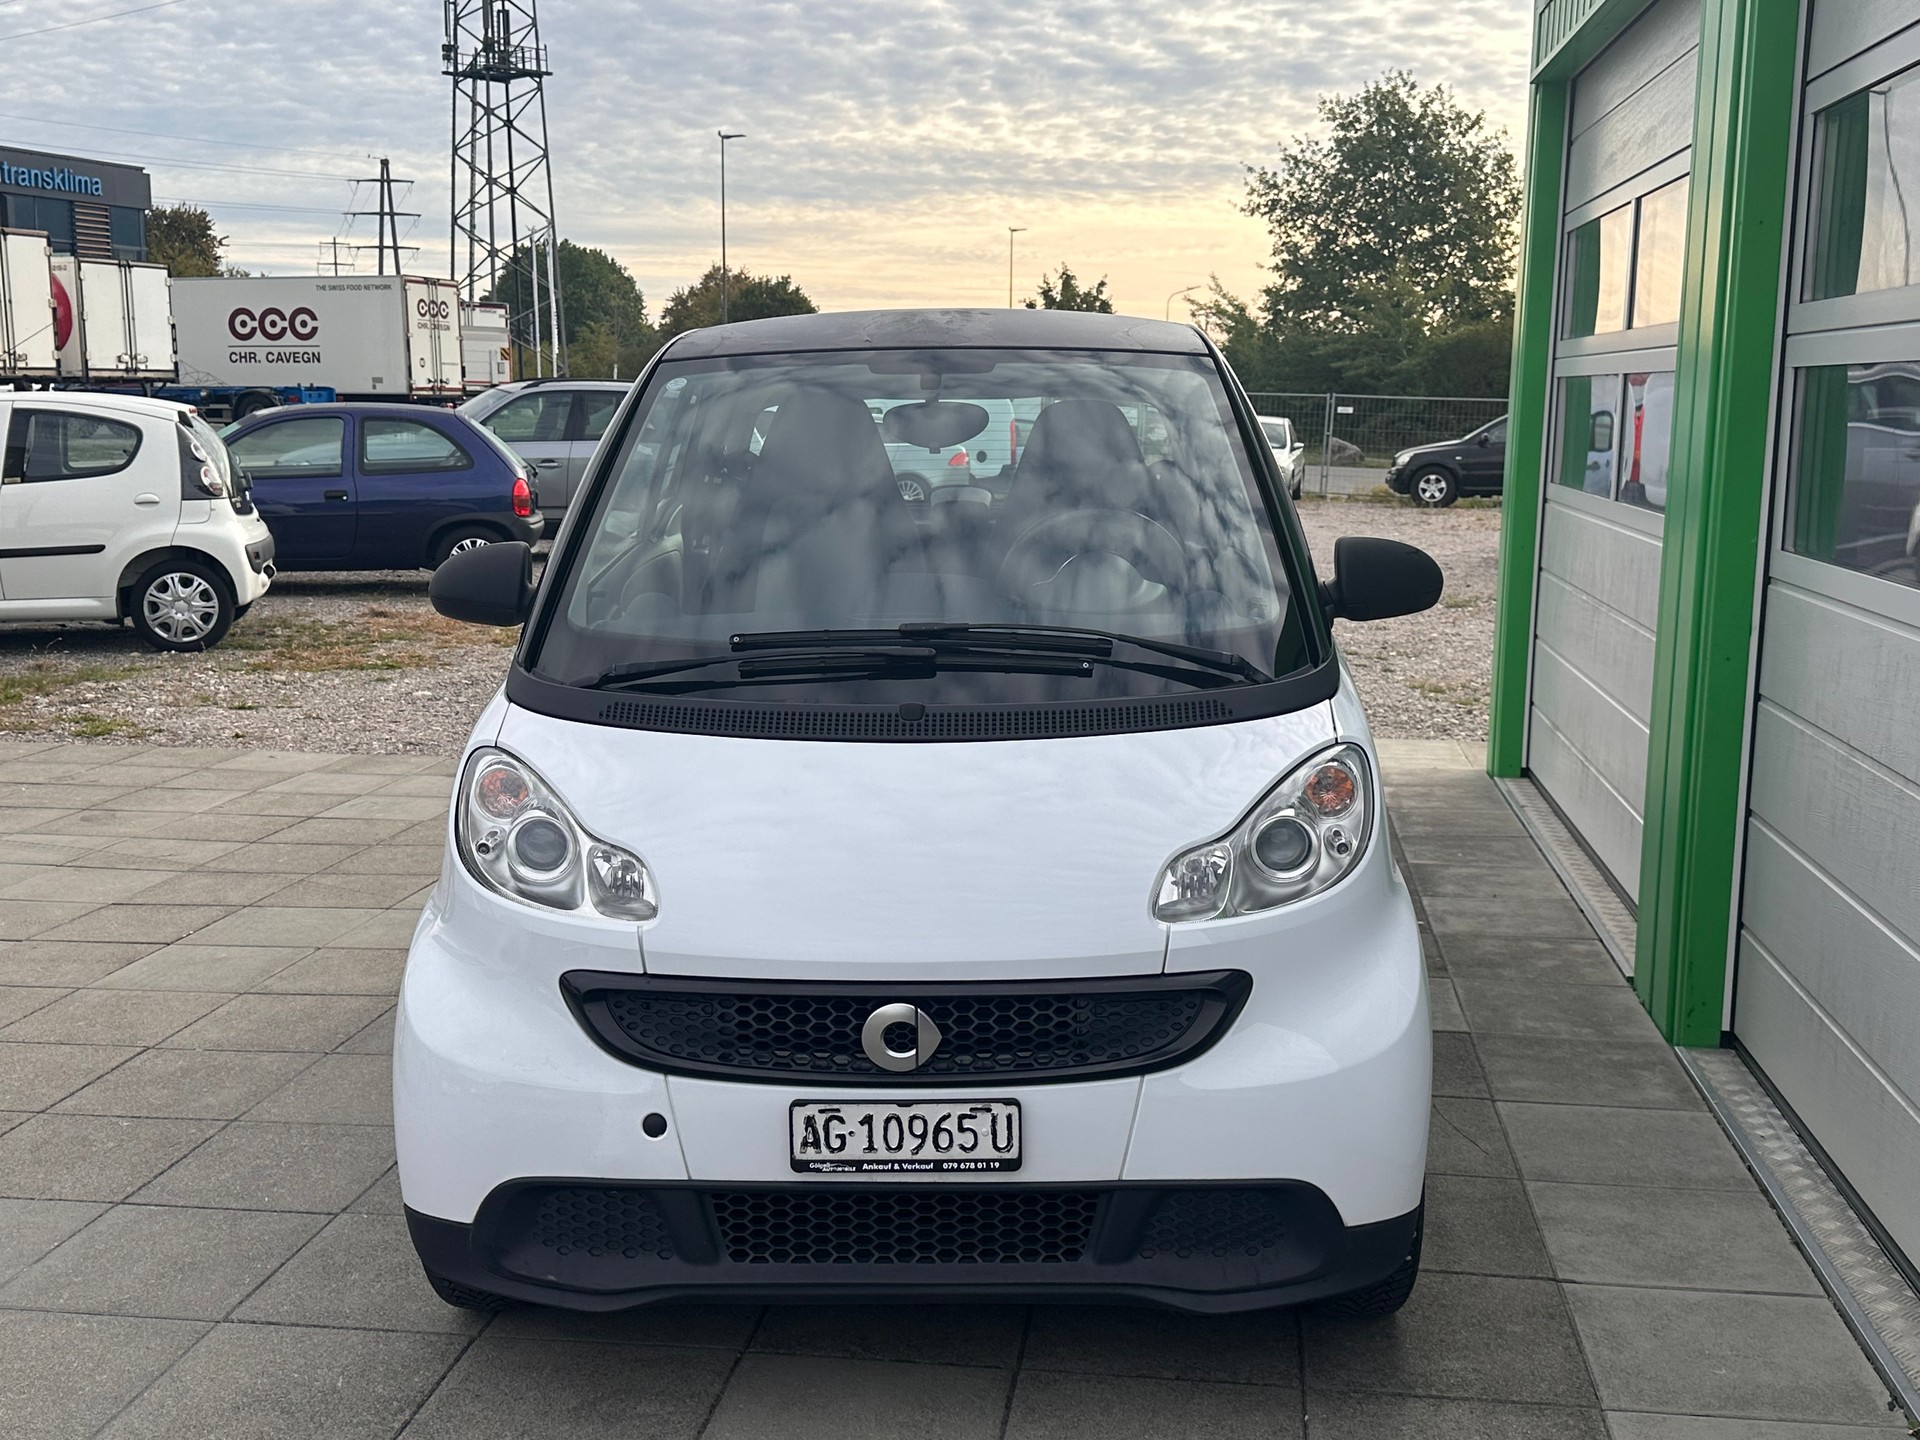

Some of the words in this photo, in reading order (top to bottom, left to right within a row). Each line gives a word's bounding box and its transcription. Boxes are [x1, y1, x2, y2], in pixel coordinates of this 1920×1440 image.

[2, 160, 103, 196] transklima
[228, 306, 319, 341] CCC
[229, 351, 261, 364] CHR.
[266, 351, 321, 364] CAVEGN
[862, 1162, 892, 1170] Ankauf
[893, 1162, 900, 1170] &
[902, 1162, 934, 1170] Verkauf
[990, 1161, 1000, 1169] 19
